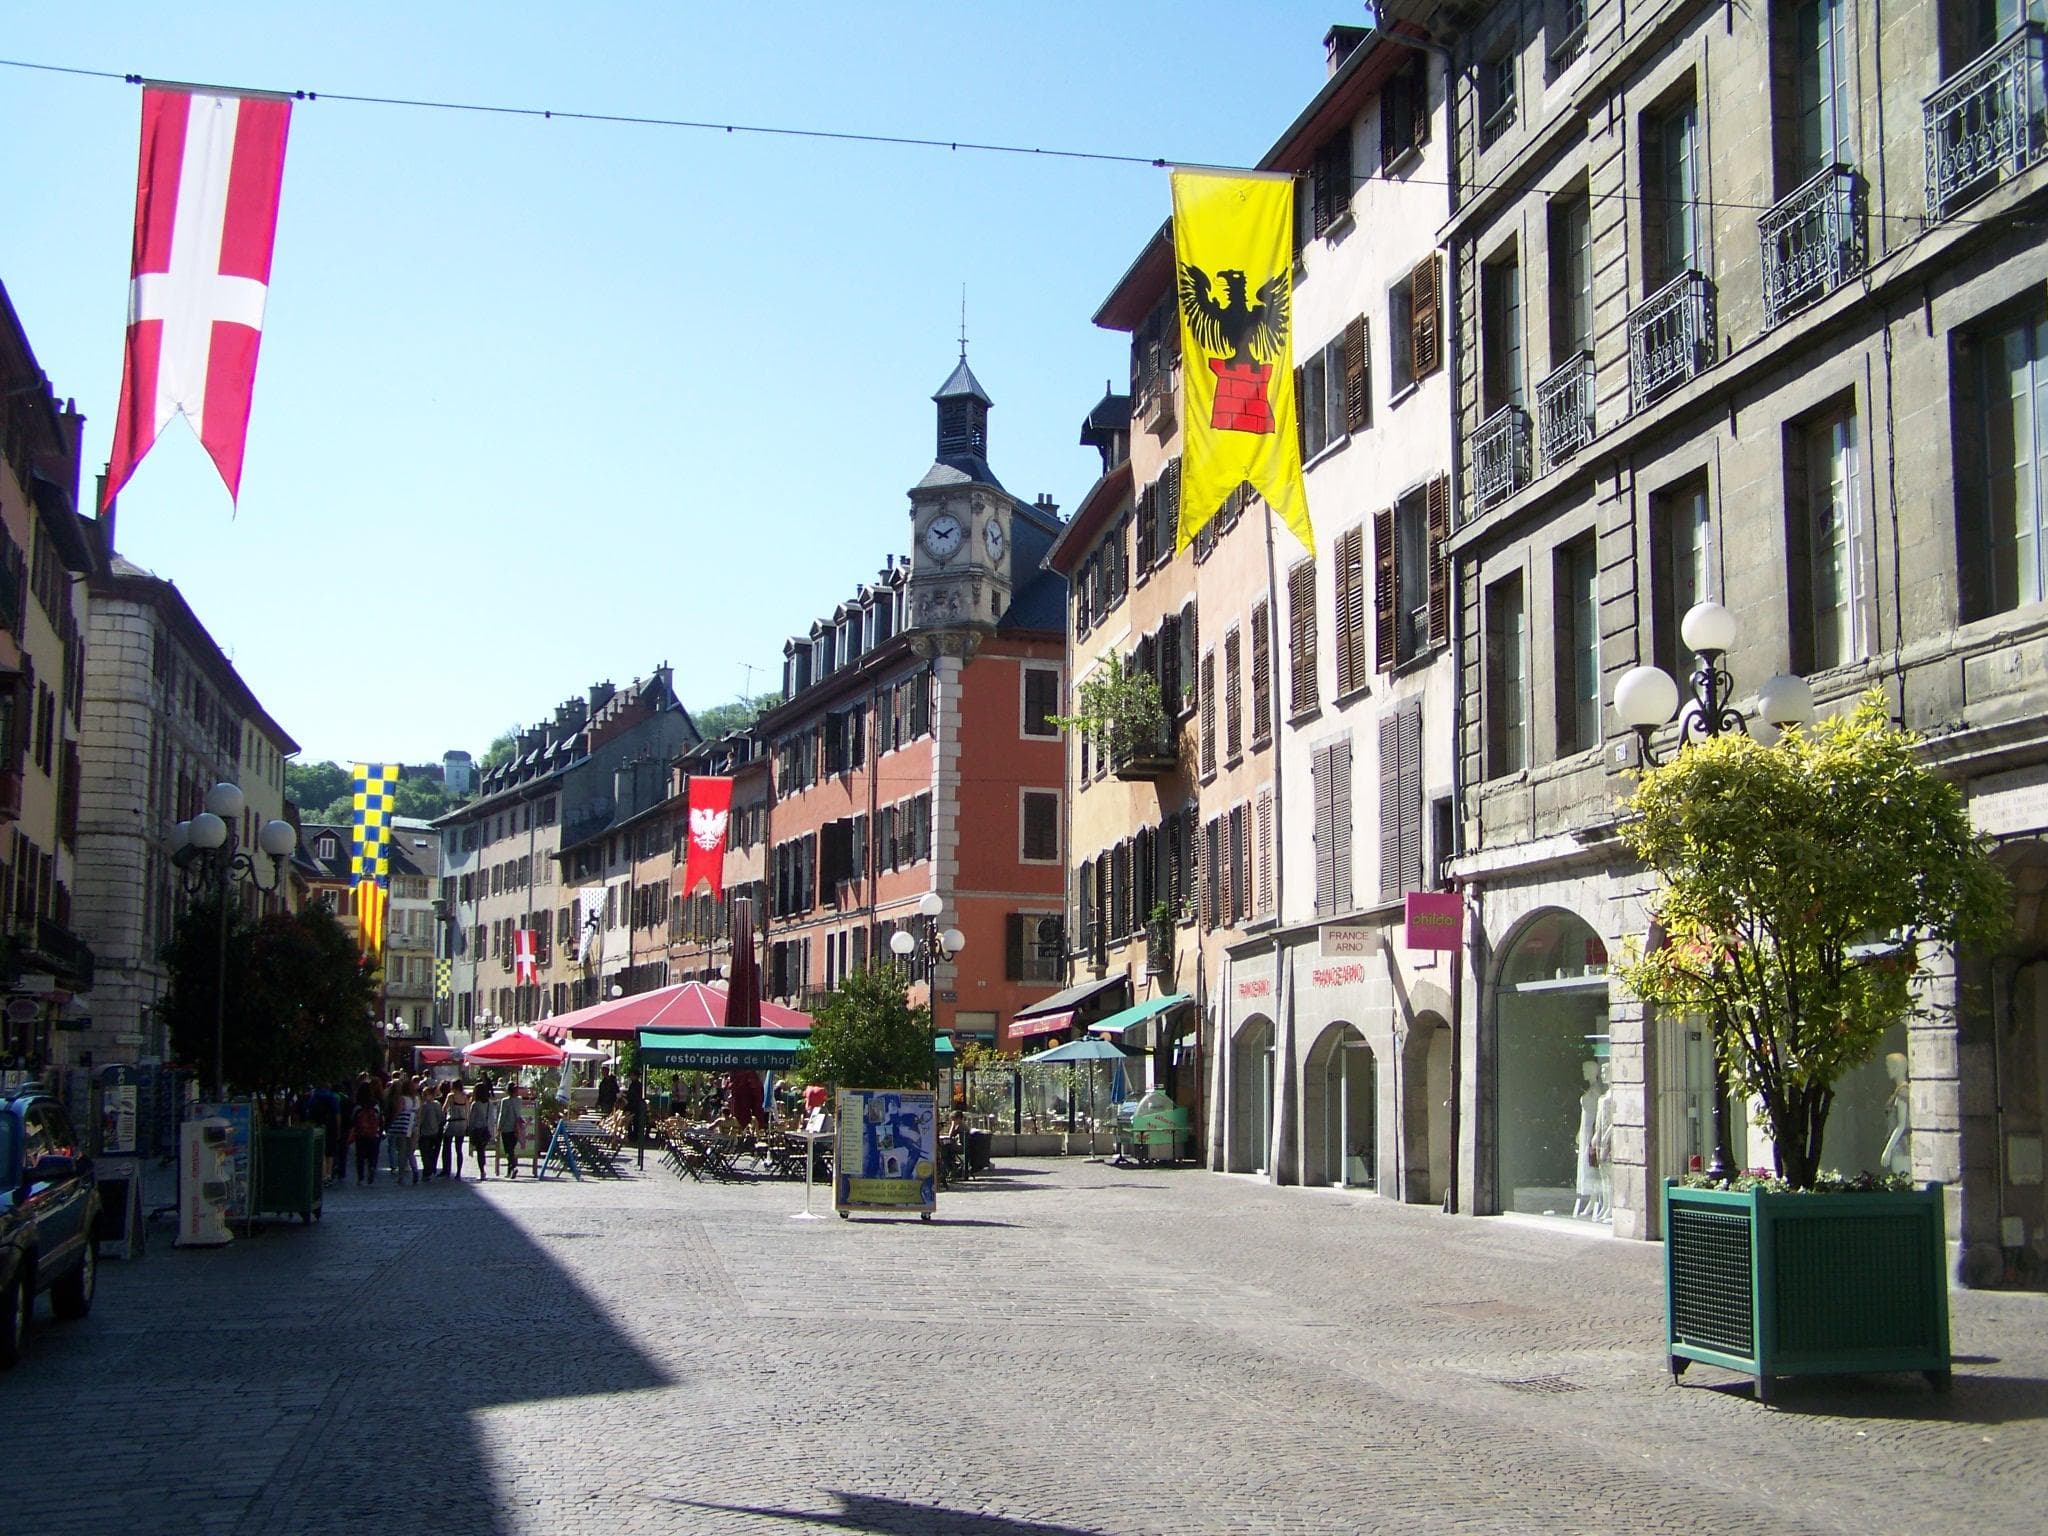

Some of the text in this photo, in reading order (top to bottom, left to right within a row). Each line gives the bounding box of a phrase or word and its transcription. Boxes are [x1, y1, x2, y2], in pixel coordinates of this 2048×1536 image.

[1329, 931, 1369, 941] FRANCE
[1335, 942, 1364, 952] ARNO
[665, 1052, 739, 1066] resto'rapide
[743, 1054, 759, 1065] de
